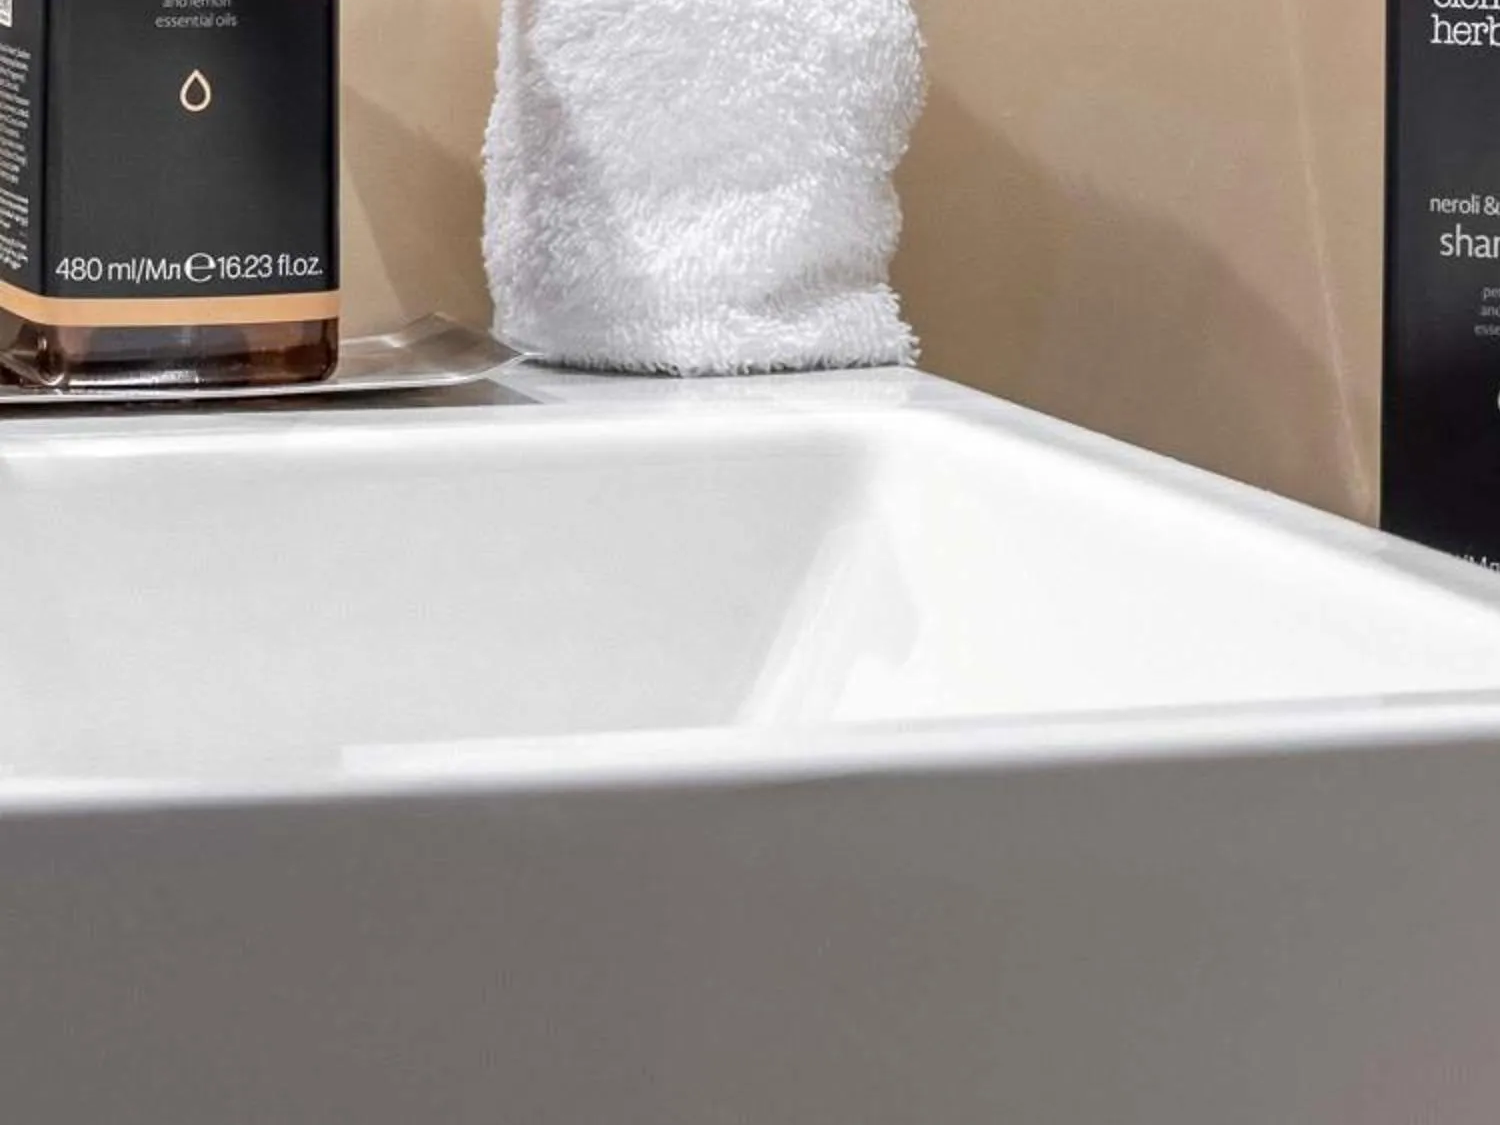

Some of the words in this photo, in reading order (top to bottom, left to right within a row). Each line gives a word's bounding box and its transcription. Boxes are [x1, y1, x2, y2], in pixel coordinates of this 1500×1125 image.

[155, 13, 214, 28] essential
[215, 13, 238, 27] oils
[1429, 193, 1480, 214] neroli
[1483, 195, 1500, 216] &
[55, 257, 102, 282] 480
